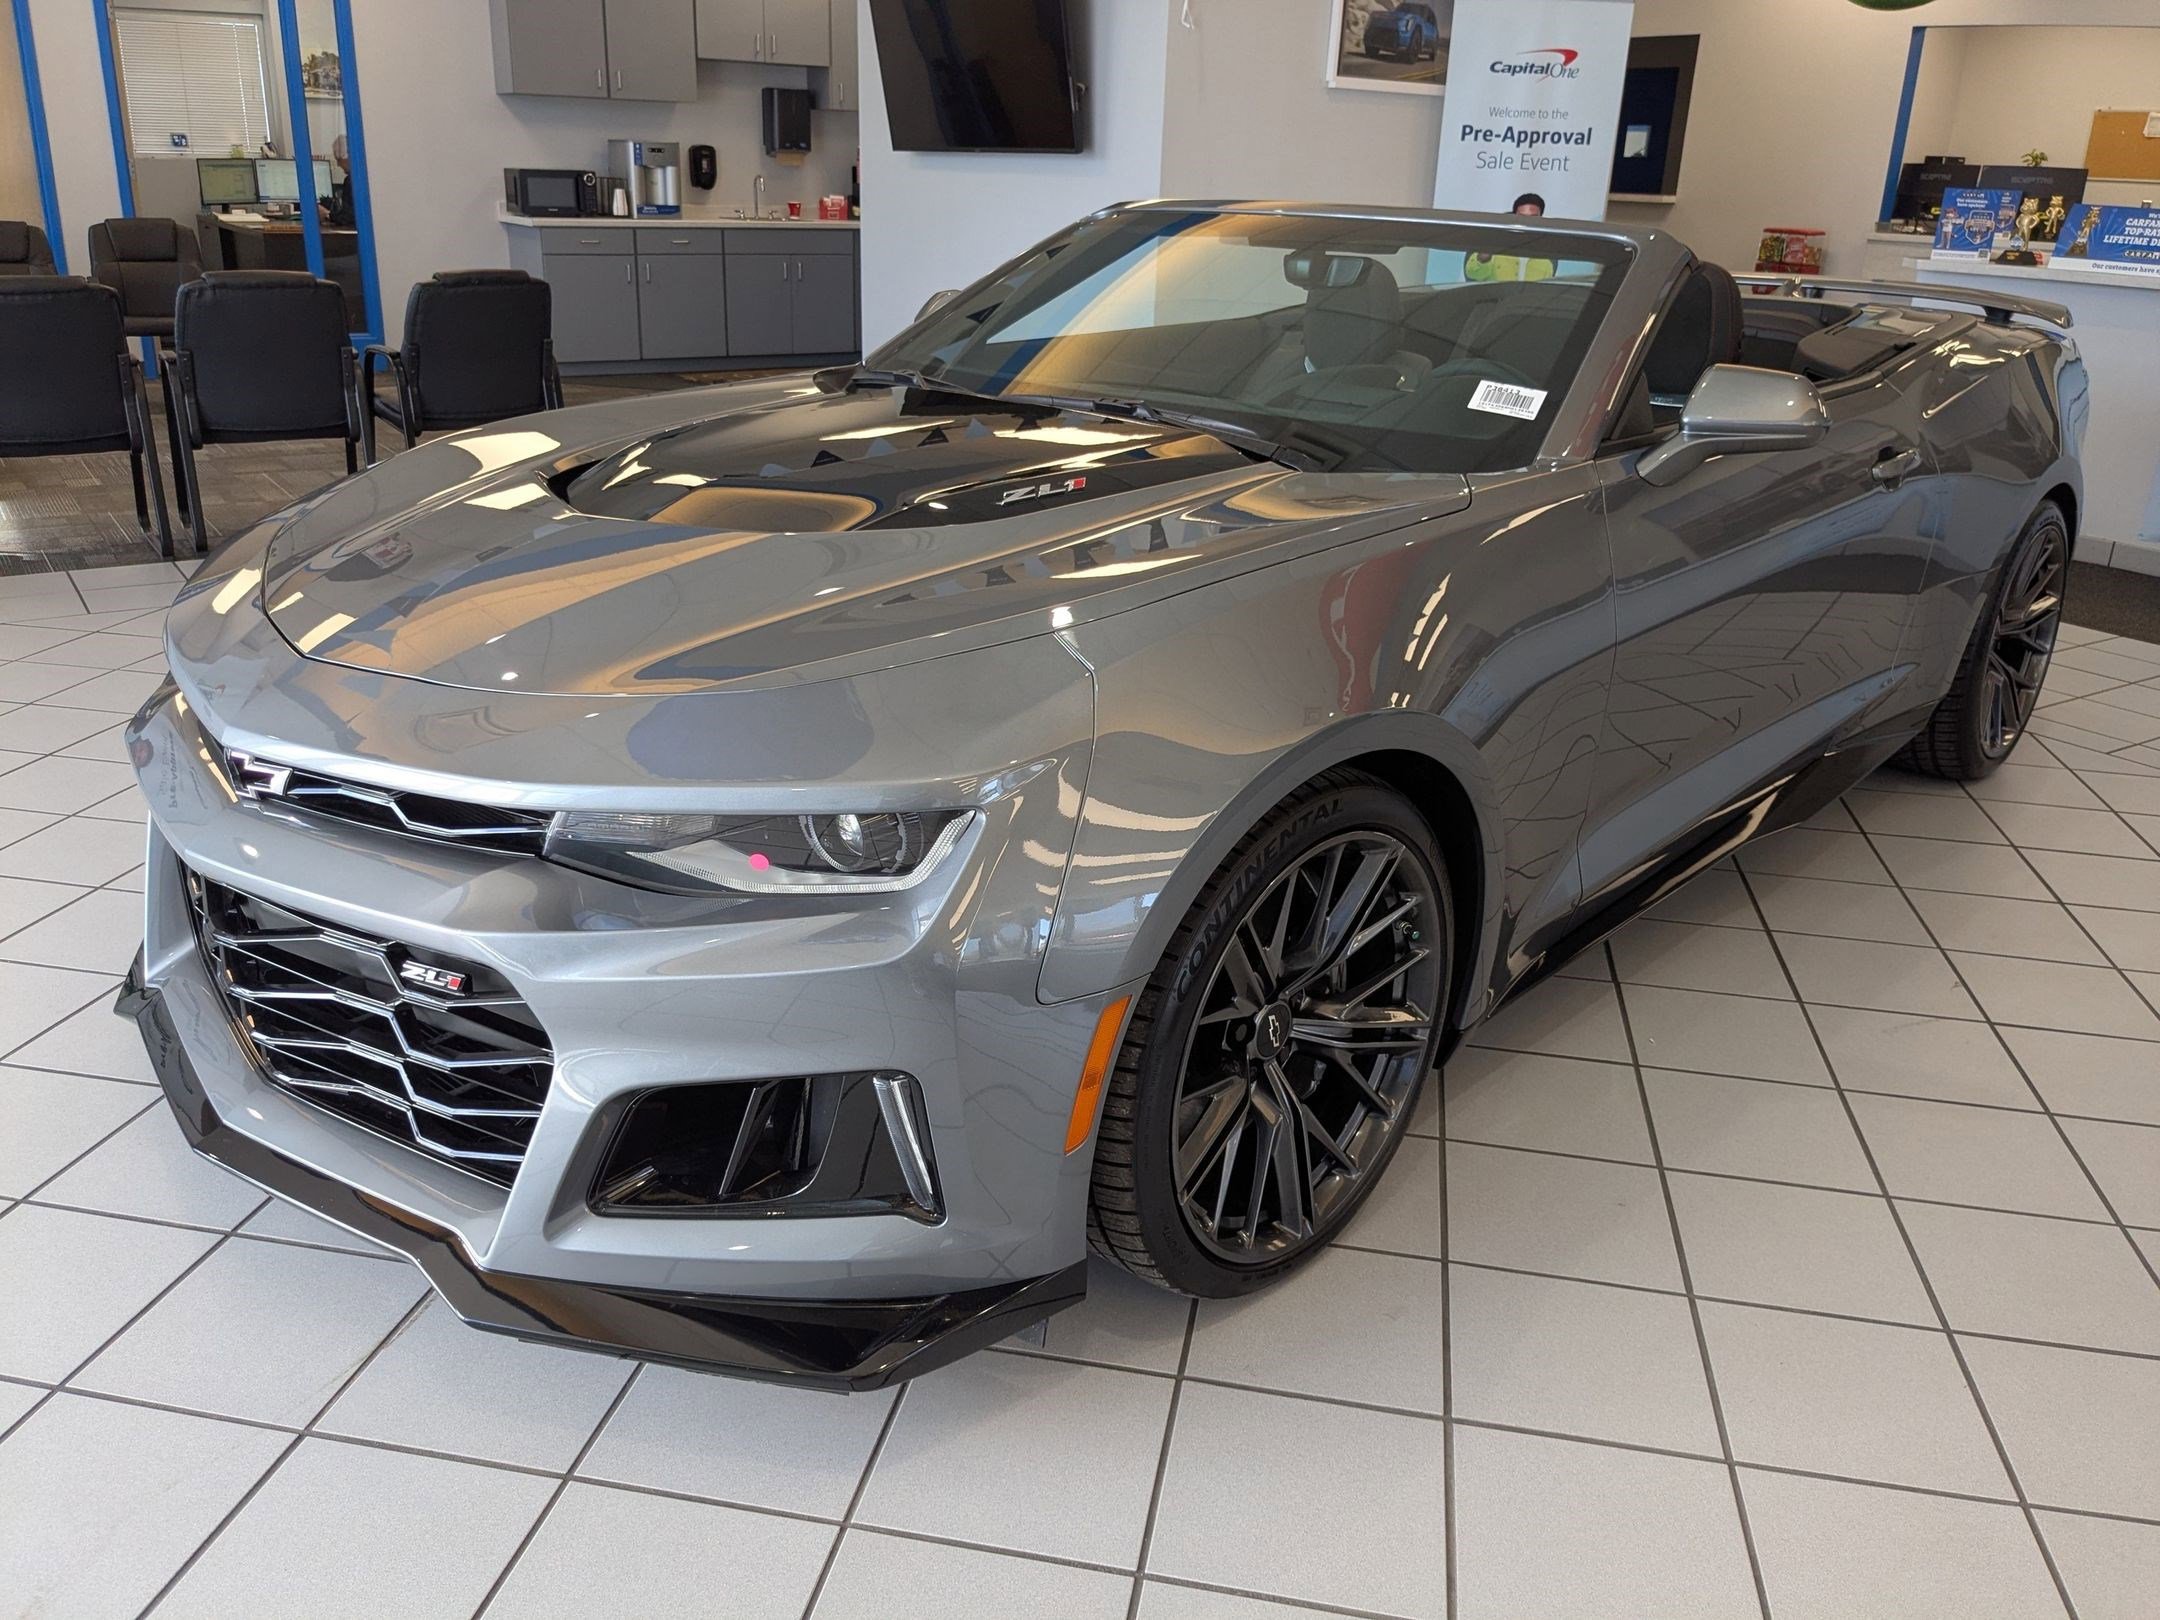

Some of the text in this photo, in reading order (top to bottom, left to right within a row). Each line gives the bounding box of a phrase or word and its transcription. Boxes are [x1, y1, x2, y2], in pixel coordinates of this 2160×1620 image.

[1489, 106, 1569, 120] Welcome to the
[1460, 124, 1593, 149] Pre-Approval
[1476, 151, 1571, 172] Sale Event
[2102, 234, 2149, 246] LIFETIME
[2091, 262, 2105, 270] Our
[2105, 263, 2138, 272] customers
[996, 477, 1086, 506] ZL1
[1175, 799, 1345, 1002] CONTINENTAL
[400, 962, 461, 991] ZL1
